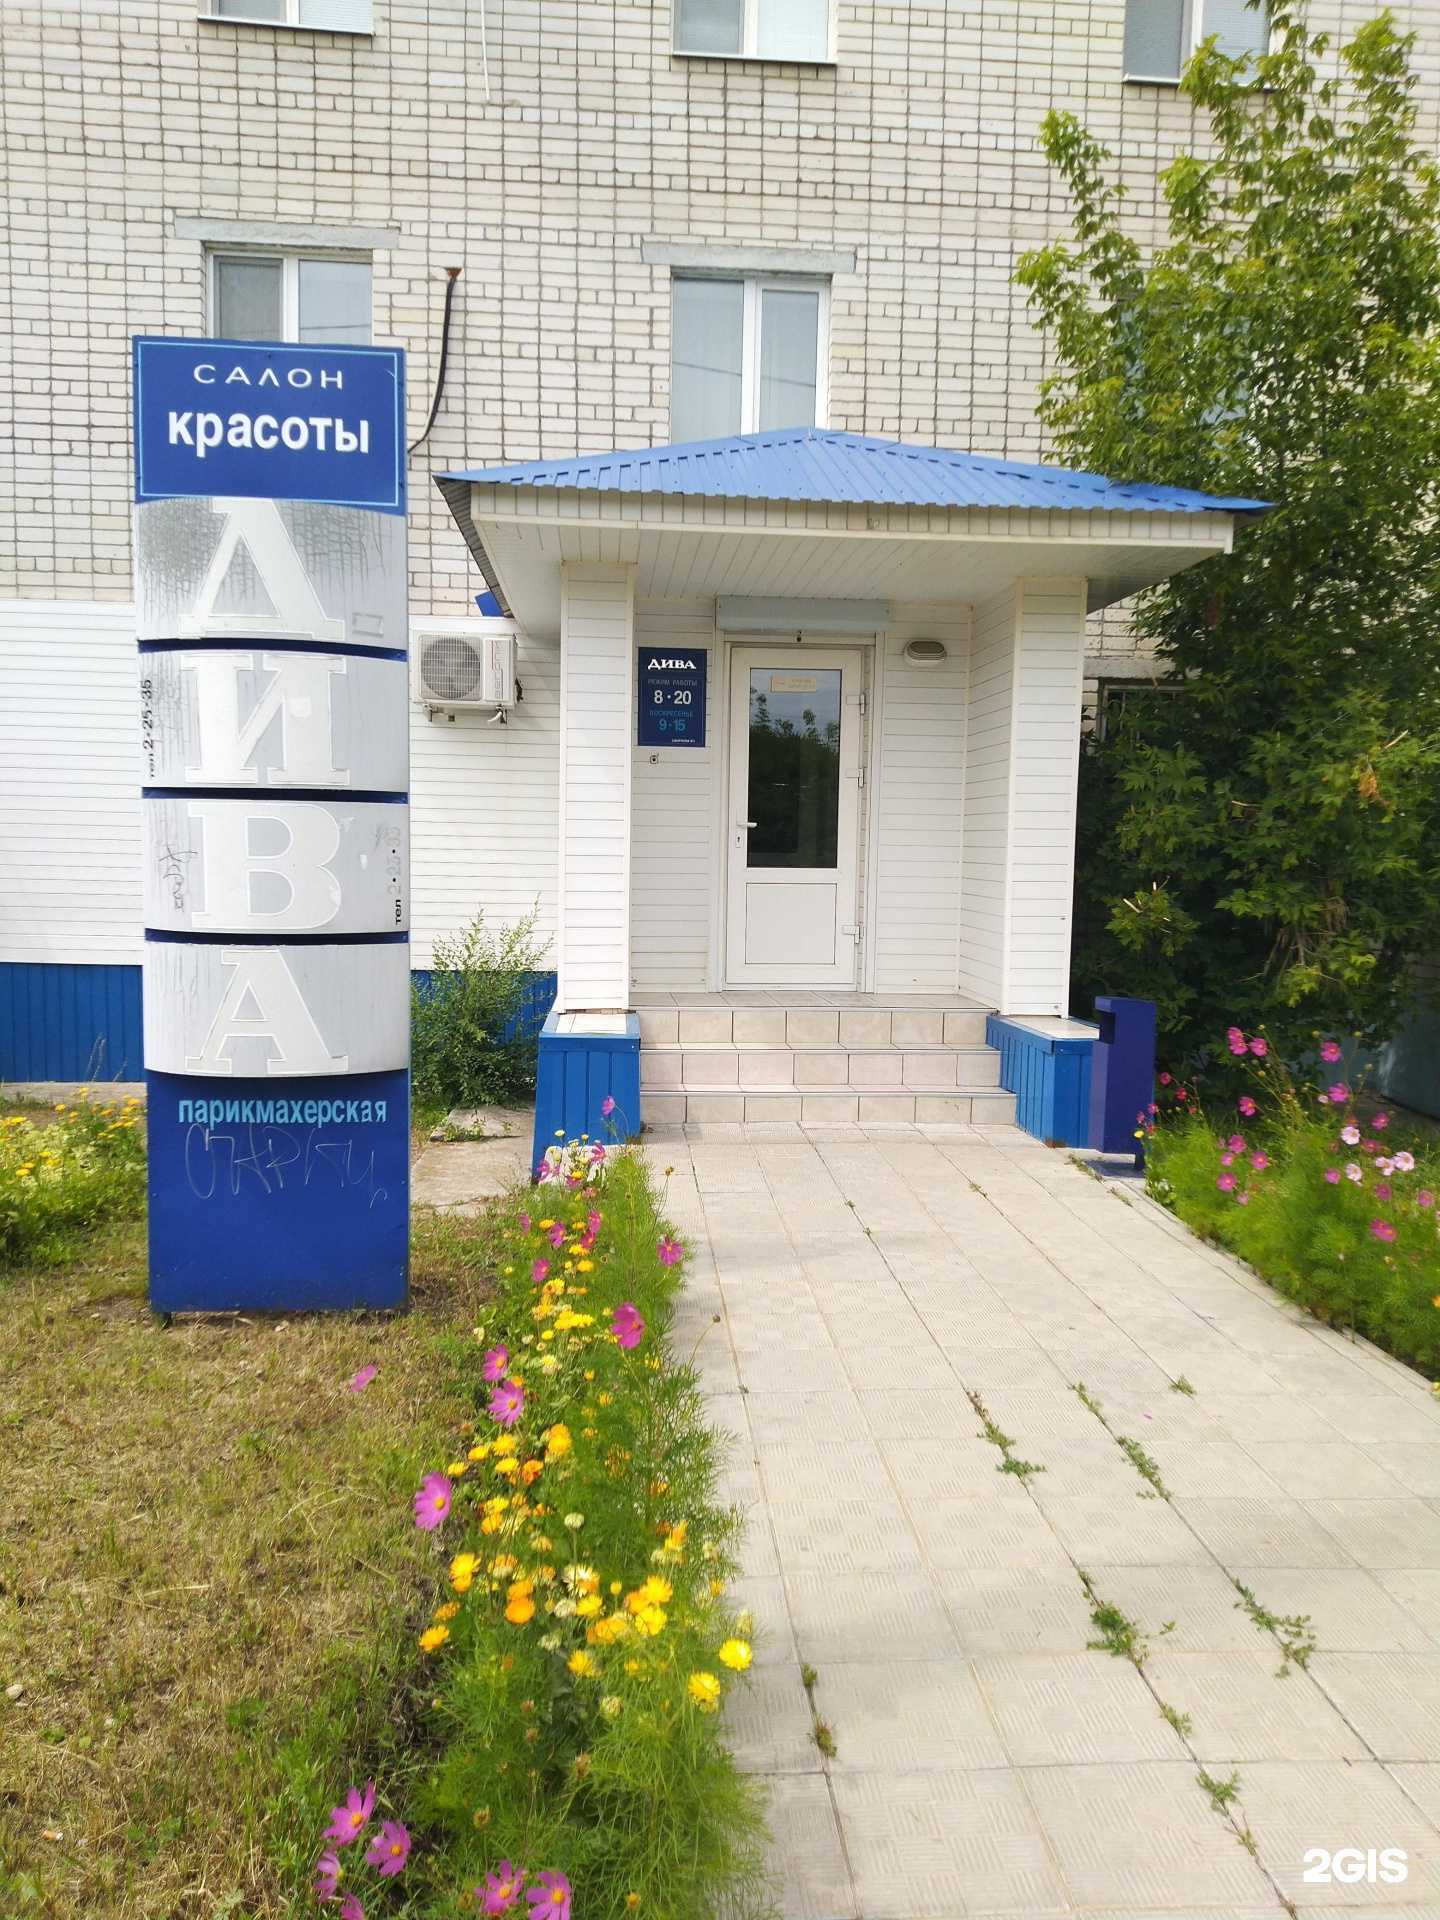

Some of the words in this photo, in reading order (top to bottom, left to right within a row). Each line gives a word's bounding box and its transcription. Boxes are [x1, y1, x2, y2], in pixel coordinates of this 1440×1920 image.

[193, 364, 343, 389] САЛОН
[168, 411, 369, 458] красоты
[647, 658, 697, 670] ДИВА
[178, 1099, 387, 1130] парикмахерская
